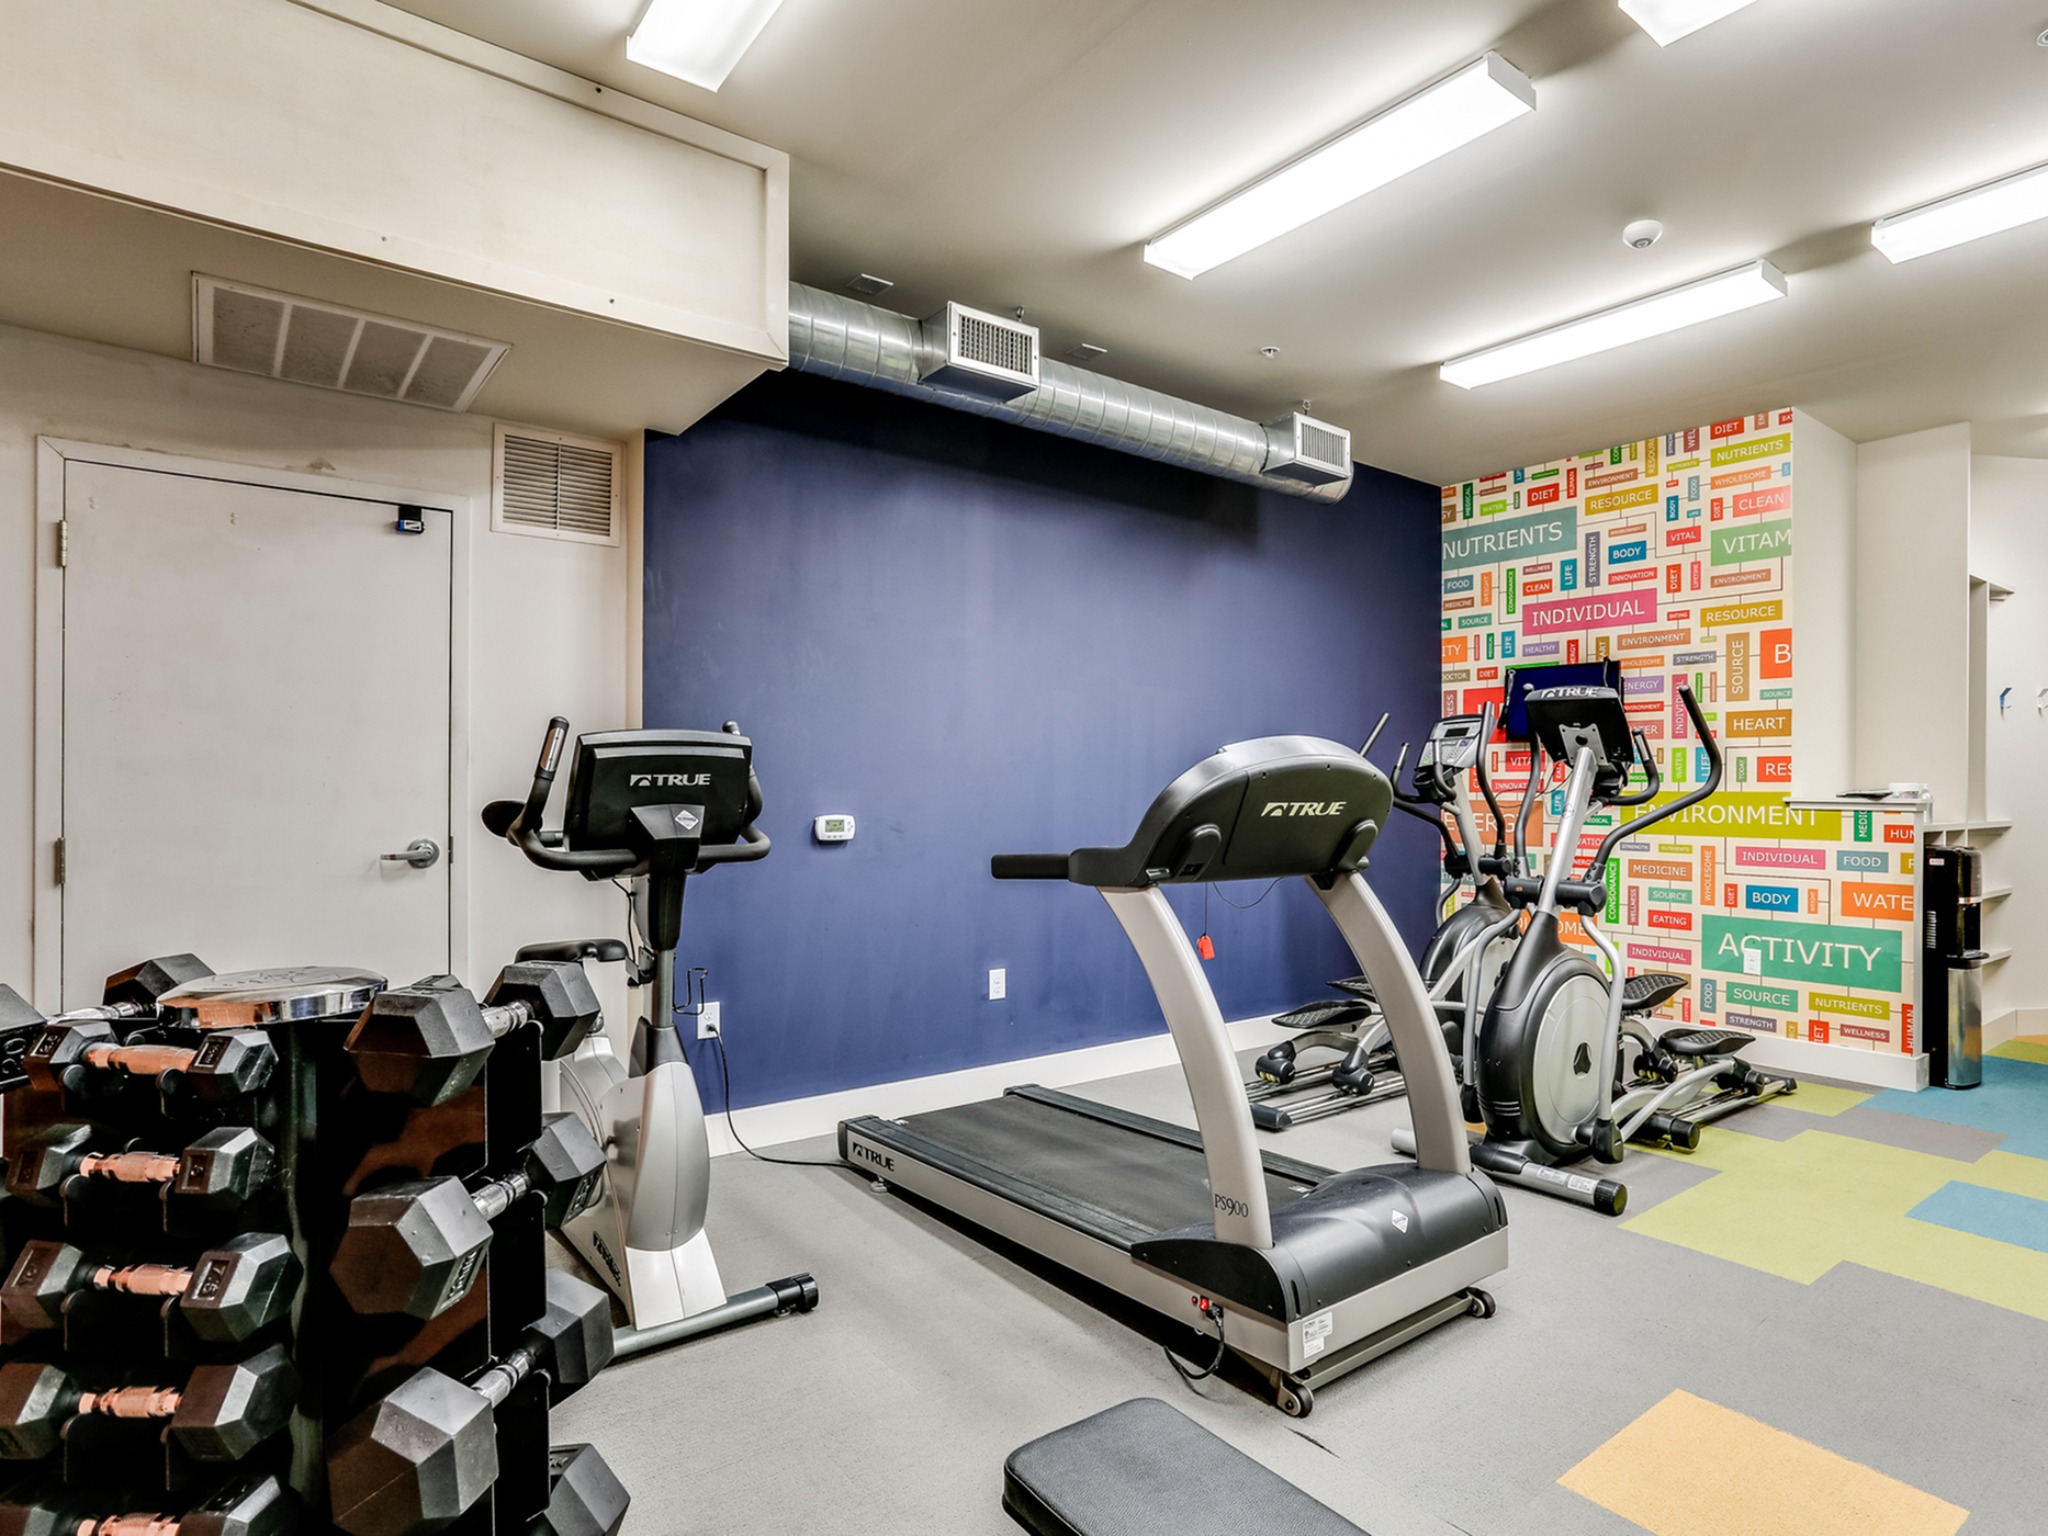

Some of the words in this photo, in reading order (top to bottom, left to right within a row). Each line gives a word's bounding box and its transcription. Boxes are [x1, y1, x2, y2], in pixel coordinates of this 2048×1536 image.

[1714, 421, 1739, 435] DIET
[1716, 439, 1784, 462] NUTRIENTS
[1588, 471, 1635, 487] ENVIRONMENT
[1714, 469, 1767, 486] WHOLESOME
[1464, 486, 1472, 517] MEDICAL
[1531, 488, 1555, 501] DIET
[1590, 489, 1653, 510] RESOURCE
[1482, 503, 1505, 514] WATER
[1738, 493, 1785, 511] CLEAN
[1713, 501, 1721, 518] DIET
[1443, 521, 1563, 560] NUTRIENTS
[1670, 531, 1697, 542] VITAL
[1722, 529, 1791, 554] VITAM
[1588, 536, 1597, 583] STRENGTH
[1612, 547, 1642, 559] BODY
[1564, 564, 1574, 586] LIFE
[1611, 570, 1655, 582] INNOVATION
[1714, 572, 1767, 585] ENVIRONMENT
[1447, 579, 1470, 589] FOOD
[1525, 583, 1550, 593] CLEAN
[1445, 600, 1473, 609] MEDICINE
[1532, 599, 1645, 627] INDIVIDUAL
[1706, 605, 1776, 622] RESOURCE
[1461, 616, 1489, 626] SOURCE
[1504, 635, 1512, 654] LIFE
[1622, 633, 1686, 646] ENVIRONMENT
[1525, 645, 1556, 654] HEALTHY
[1676, 653, 1714, 663] STRENGTH
[1731, 640, 1744, 694] SOURCE
[1558, 686, 1599, 698] TRUE
[1763, 690, 1791, 698] SOURCE
[1733, 717, 1787, 731] HEART
[653, 773, 711, 787] TRUE
[1289, 801, 1347, 816] TRUE
[1554, 795, 1562, 812] LIFE
[1444, 812, 1521, 832] EERG
[1742, 851, 1818, 865] INDIVIDUAL
[1843, 856, 1882, 868] FOOD
[1633, 864, 1687, 877] MEDICINE
[1704, 849, 1712, 901] WHOLESOME
[1608, 861, 1617, 920] CONSONANCE
[1652, 890, 1688, 901] SOURCE
[1727, 887, 1735, 905] DIET
[1752, 892, 1791, 905] BODY
[1853, 892, 1914, 911] WATE
[1653, 915, 1687, 926] EATING
[1632, 947, 1687, 961] INDIVIDUAL
[1704, 983, 1713, 1009] FOOD
[1733, 987, 1791, 1006] SOURCE
[1814, 997, 1883, 1015] NUTRIENTS
[1729, 1015, 1774, 1029] STRENGTH
[1843, 1027, 1887, 1040] WELLNESS
[863, 1143, 895, 1173] TRUE
[1214, 1193, 1249, 1219] PS900
